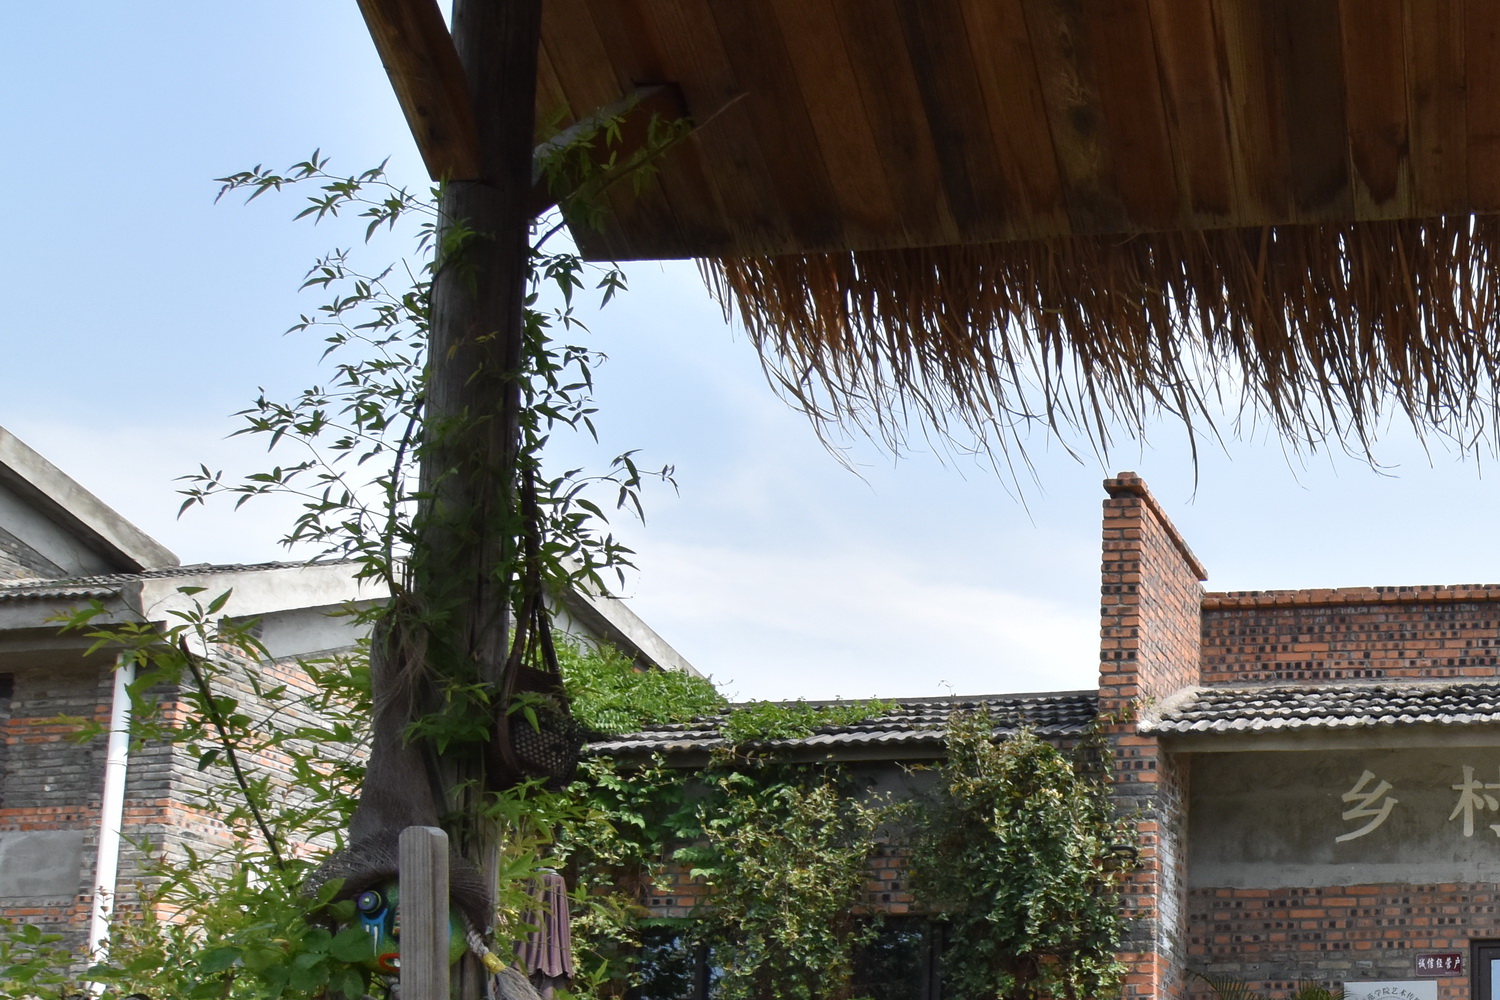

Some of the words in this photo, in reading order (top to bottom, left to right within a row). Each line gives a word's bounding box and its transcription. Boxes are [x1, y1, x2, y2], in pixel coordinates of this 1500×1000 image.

[1418, 956, 1461, 970] 诚信经营户
